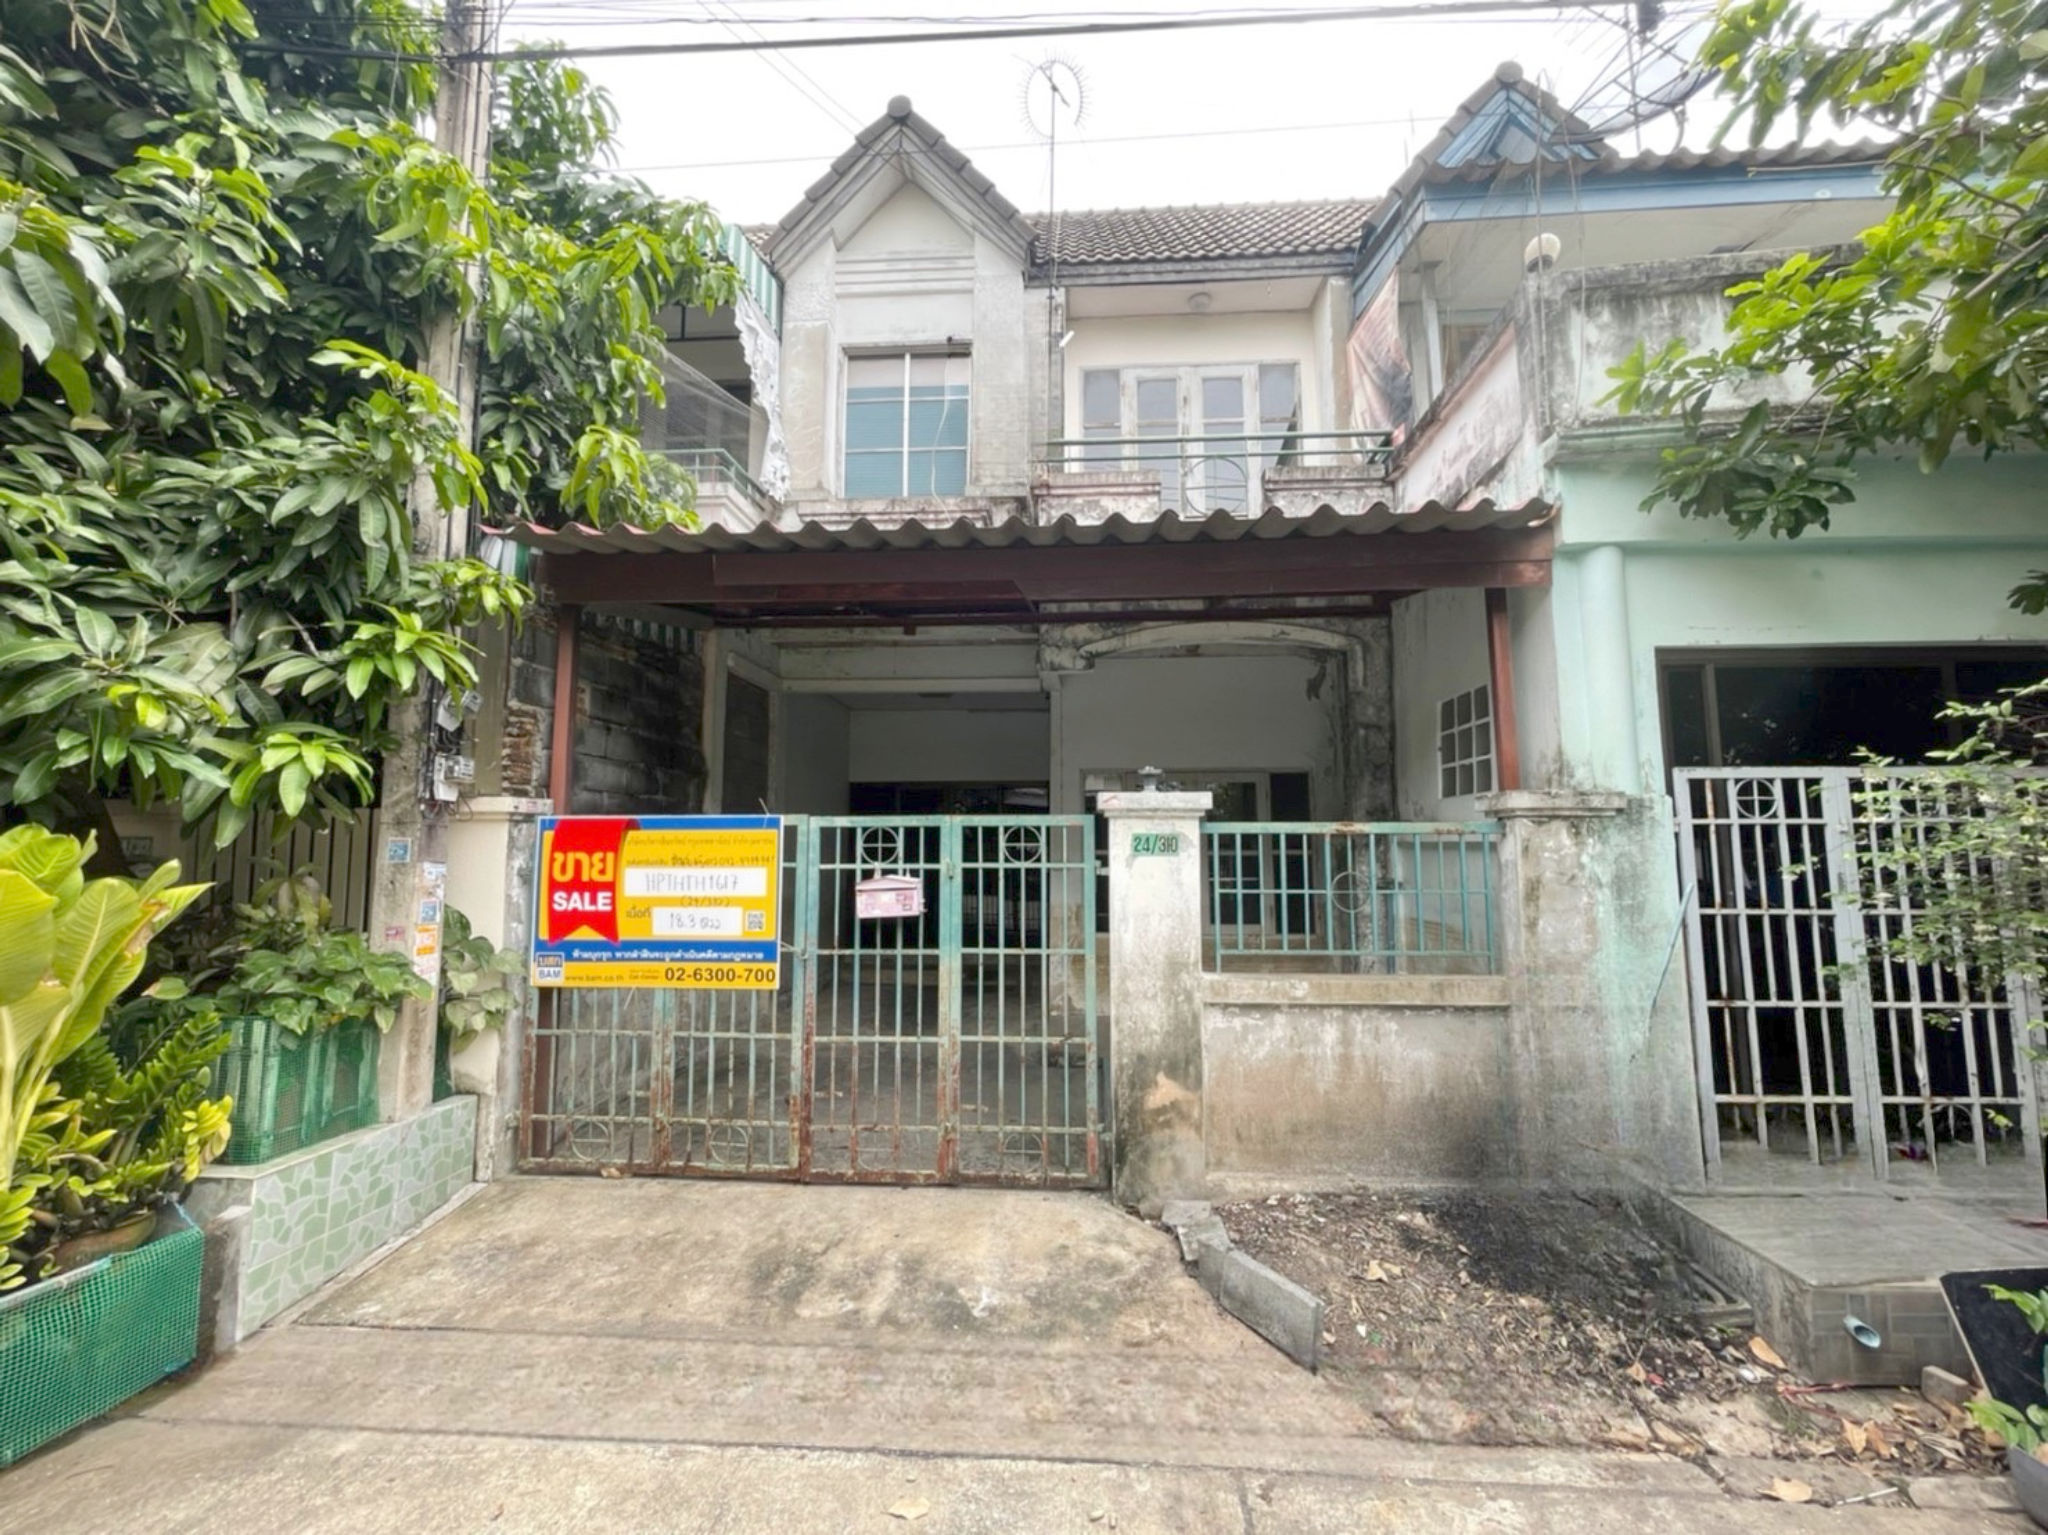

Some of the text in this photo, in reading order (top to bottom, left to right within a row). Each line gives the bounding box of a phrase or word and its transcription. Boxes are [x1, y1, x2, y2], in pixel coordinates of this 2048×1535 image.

[1133, 833, 1179, 854] 24/310
[551, 851, 614, 882] ขาย
[552, 891, 612, 912] SALE
[538, 969, 561, 979] BAM
[665, 967, 776, 982] 02-6300-700
